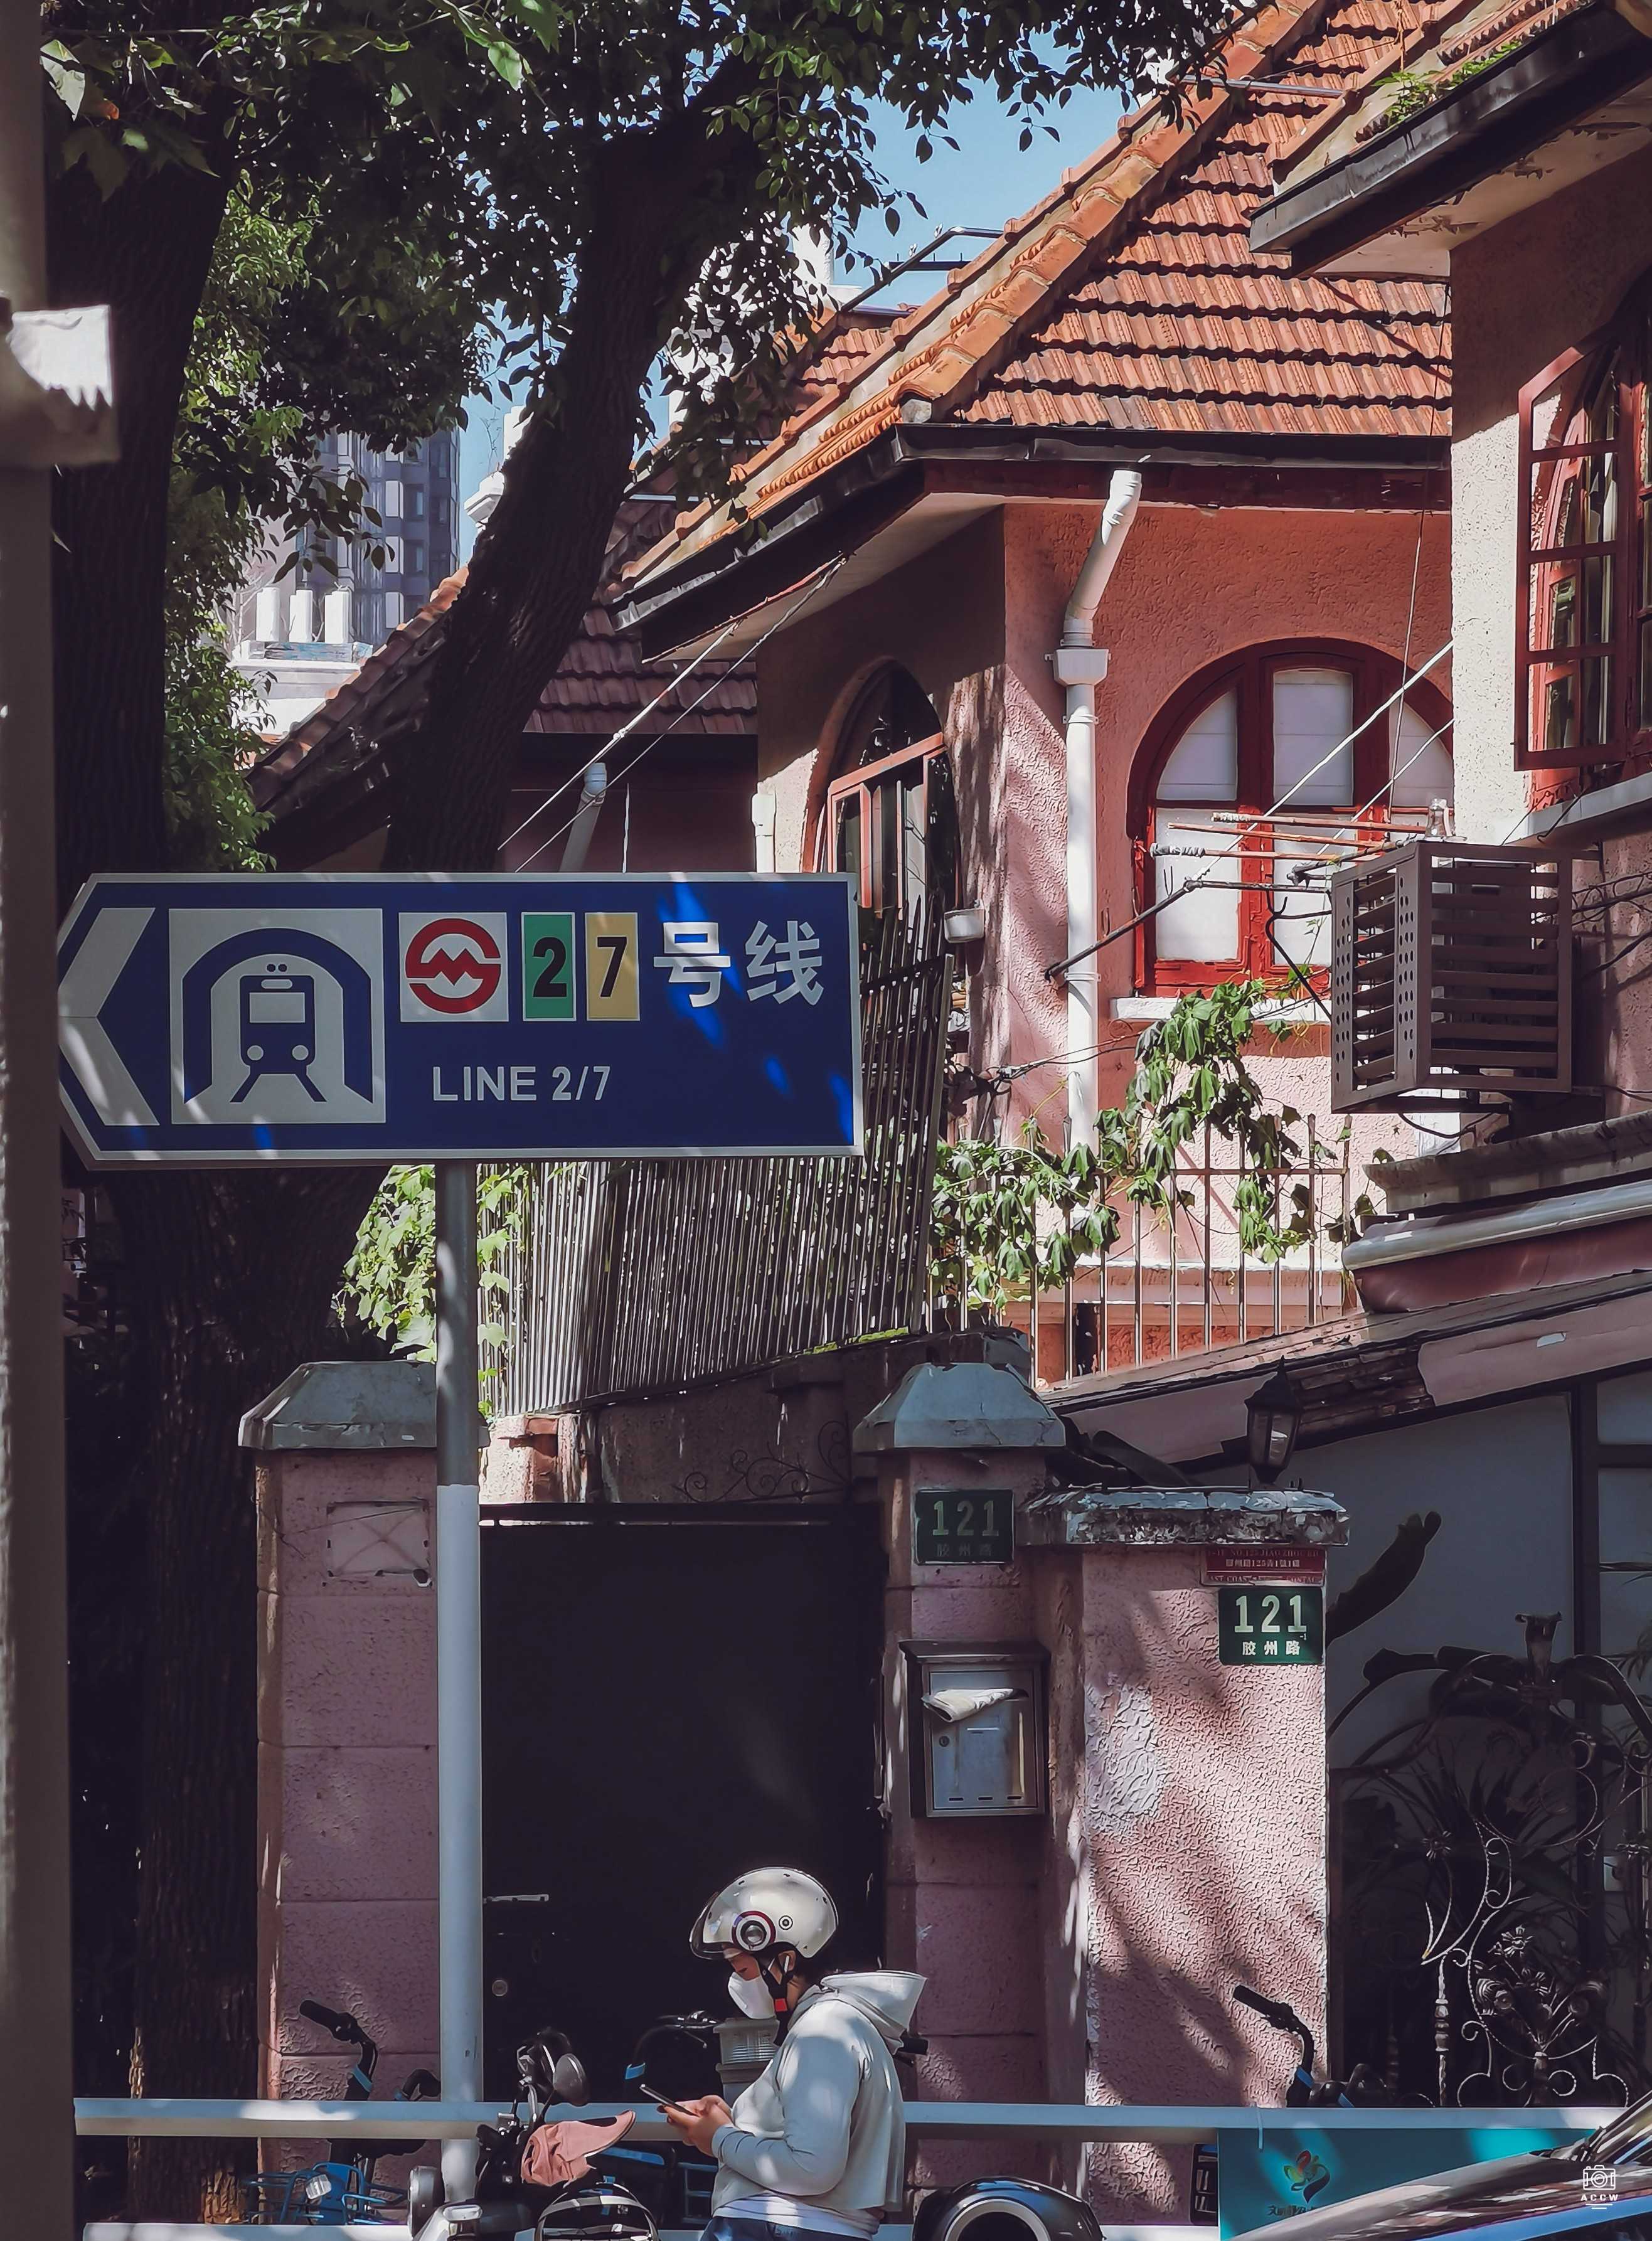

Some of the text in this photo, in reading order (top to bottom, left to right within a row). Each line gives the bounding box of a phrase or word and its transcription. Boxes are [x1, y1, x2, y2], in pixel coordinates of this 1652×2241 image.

[532, 920, 824, 1008] 2 7 号线
[433, 1066, 611, 1101] LINE 2/7
[932, 1500, 999, 1536] 121
[1234, 1595, 1307, 1632] 121
[1242, 1640, 1301, 1656] 胶州路
